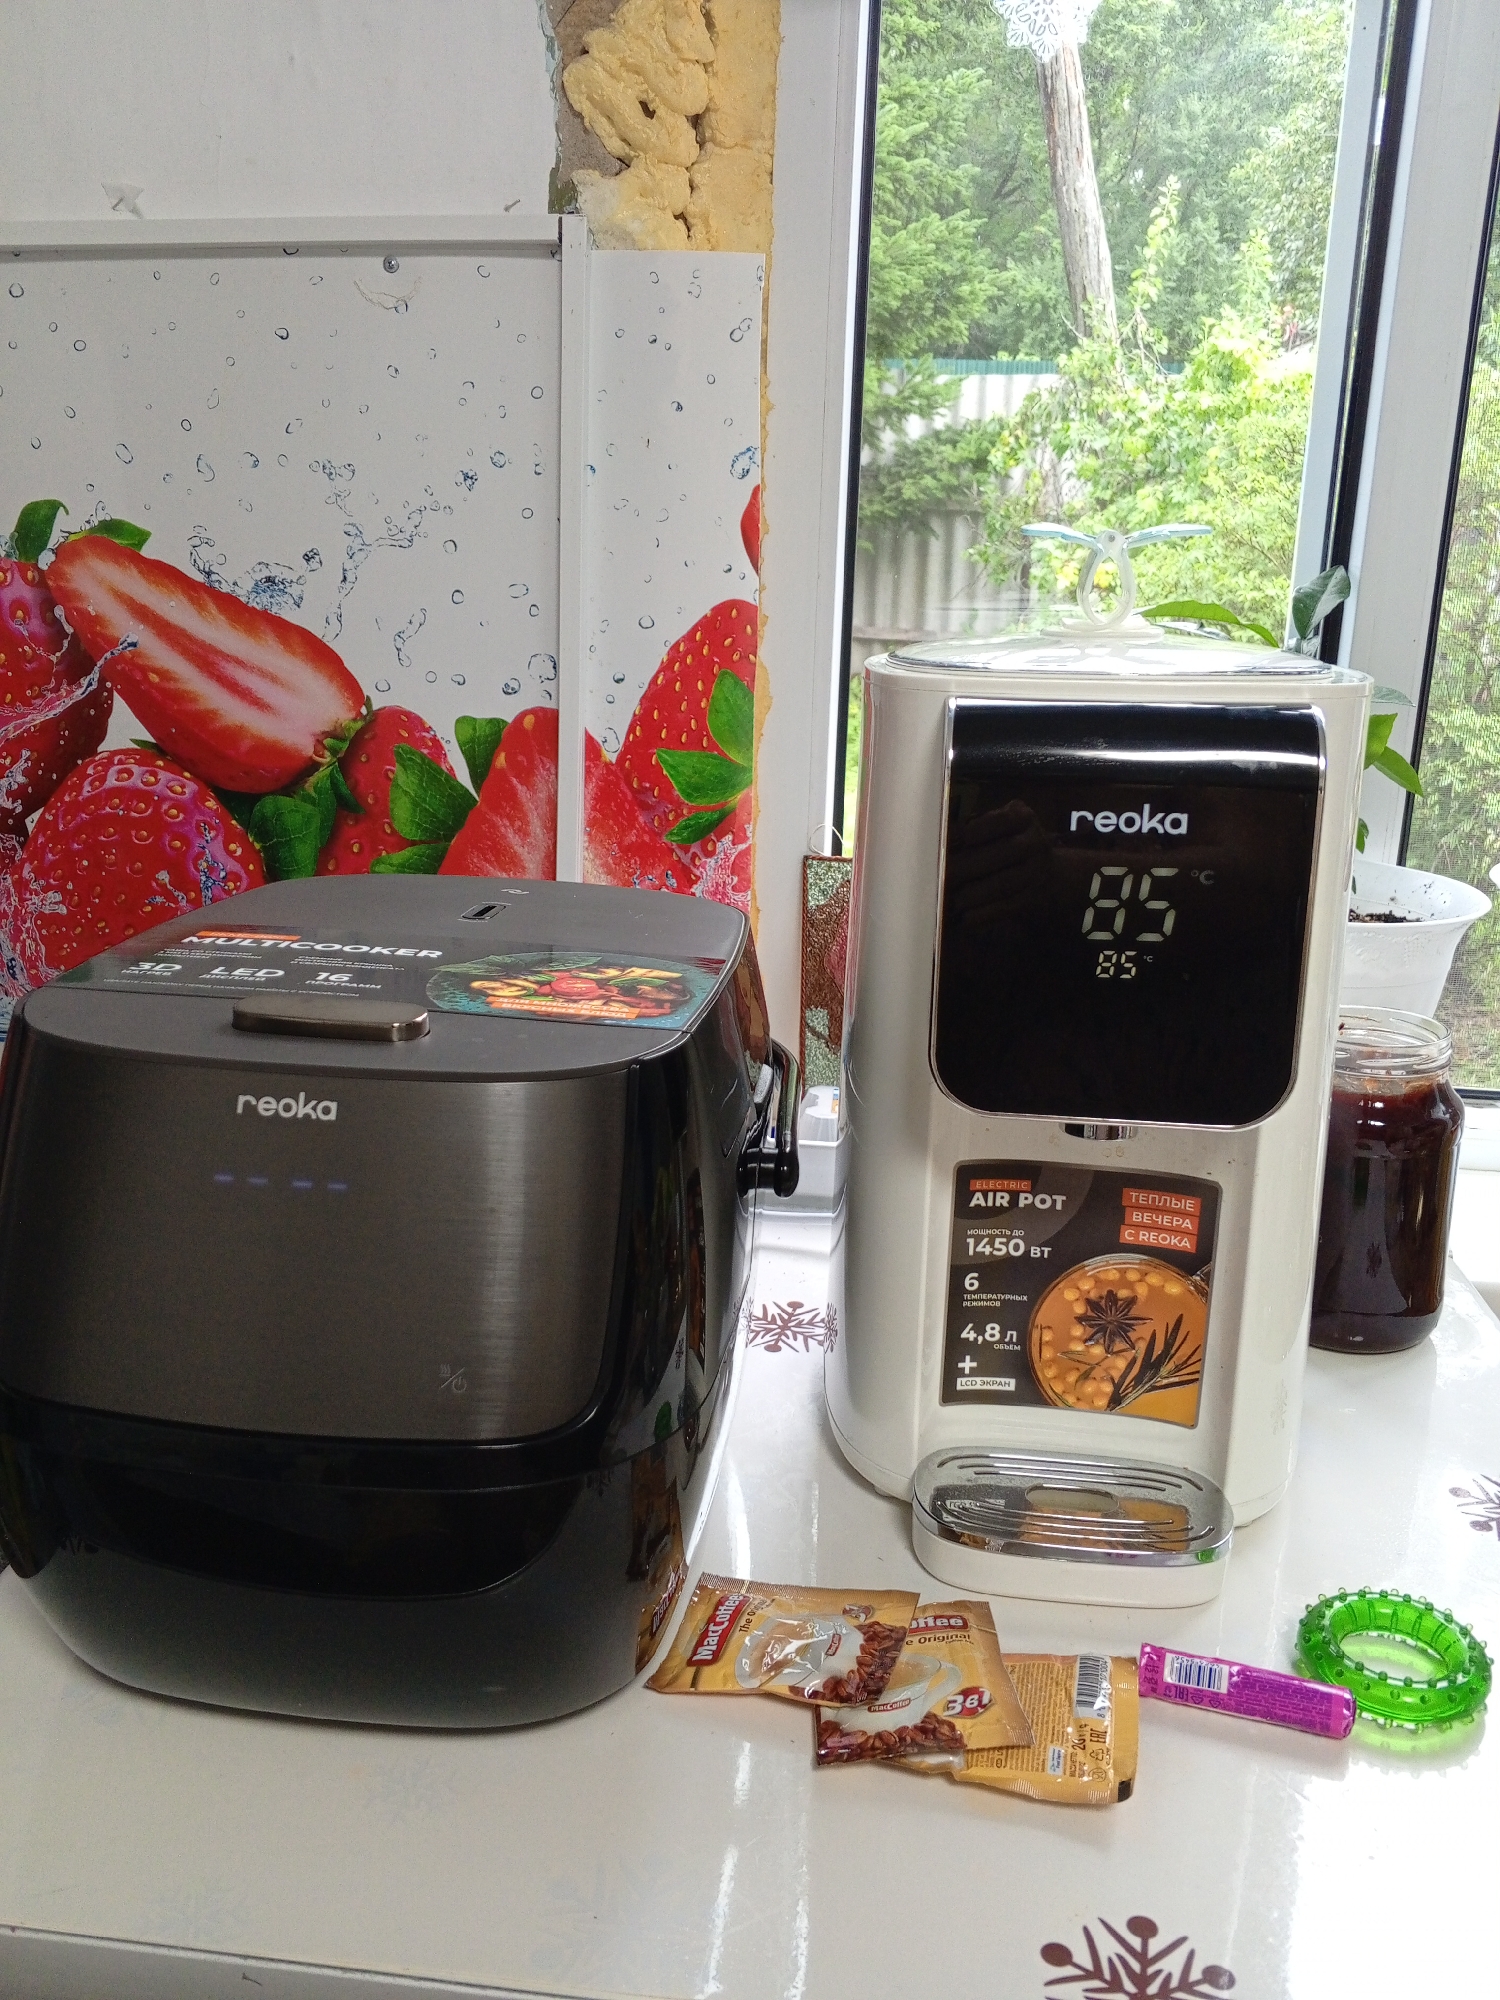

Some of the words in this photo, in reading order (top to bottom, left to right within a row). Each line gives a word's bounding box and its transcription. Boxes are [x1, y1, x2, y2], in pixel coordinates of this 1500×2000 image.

[1070, 803, 1189, 835] reoka
[1081, 866, 1179, 942] 85
[180, 936, 443, 958] MULTICOOKER
[129, 962, 182, 971] 3D
[210, 966, 285, 977] LED
[1095, 950, 1137, 979] 85
[305, 980, 382, 989] ПРОГРАММ
[315, 972, 354, 982] 16
[236, 1091, 338, 1121] reoka
[976, 1180, 1028, 1190] ELECTRIC
[969, 1191, 1010, 1208] AIR
[1018, 1193, 1067, 1211] POT
[1130, 1191, 1195, 1211] ТЕПЛЫЕ
[1132, 1211, 1193, 1230] ВЕЧЕРА
[967, 1228, 1011, 1236] МОЩНОСТЬ
[1139, 1231, 1191, 1249] REOKA
[966, 1237, 1025, 1257] 1450
[964, 1272, 980, 1291] 6
[963, 1293, 1028, 1302] ТЕМПЕРАТУРНЫХ
[960, 1322, 1001, 1344] 4,8
[960, 1379, 977, 1387] LCD
[979, 1379, 1012, 1388] ЭКРАН
[738, 1616, 753, 1633] The
[918, 1633, 971, 1645] Original
